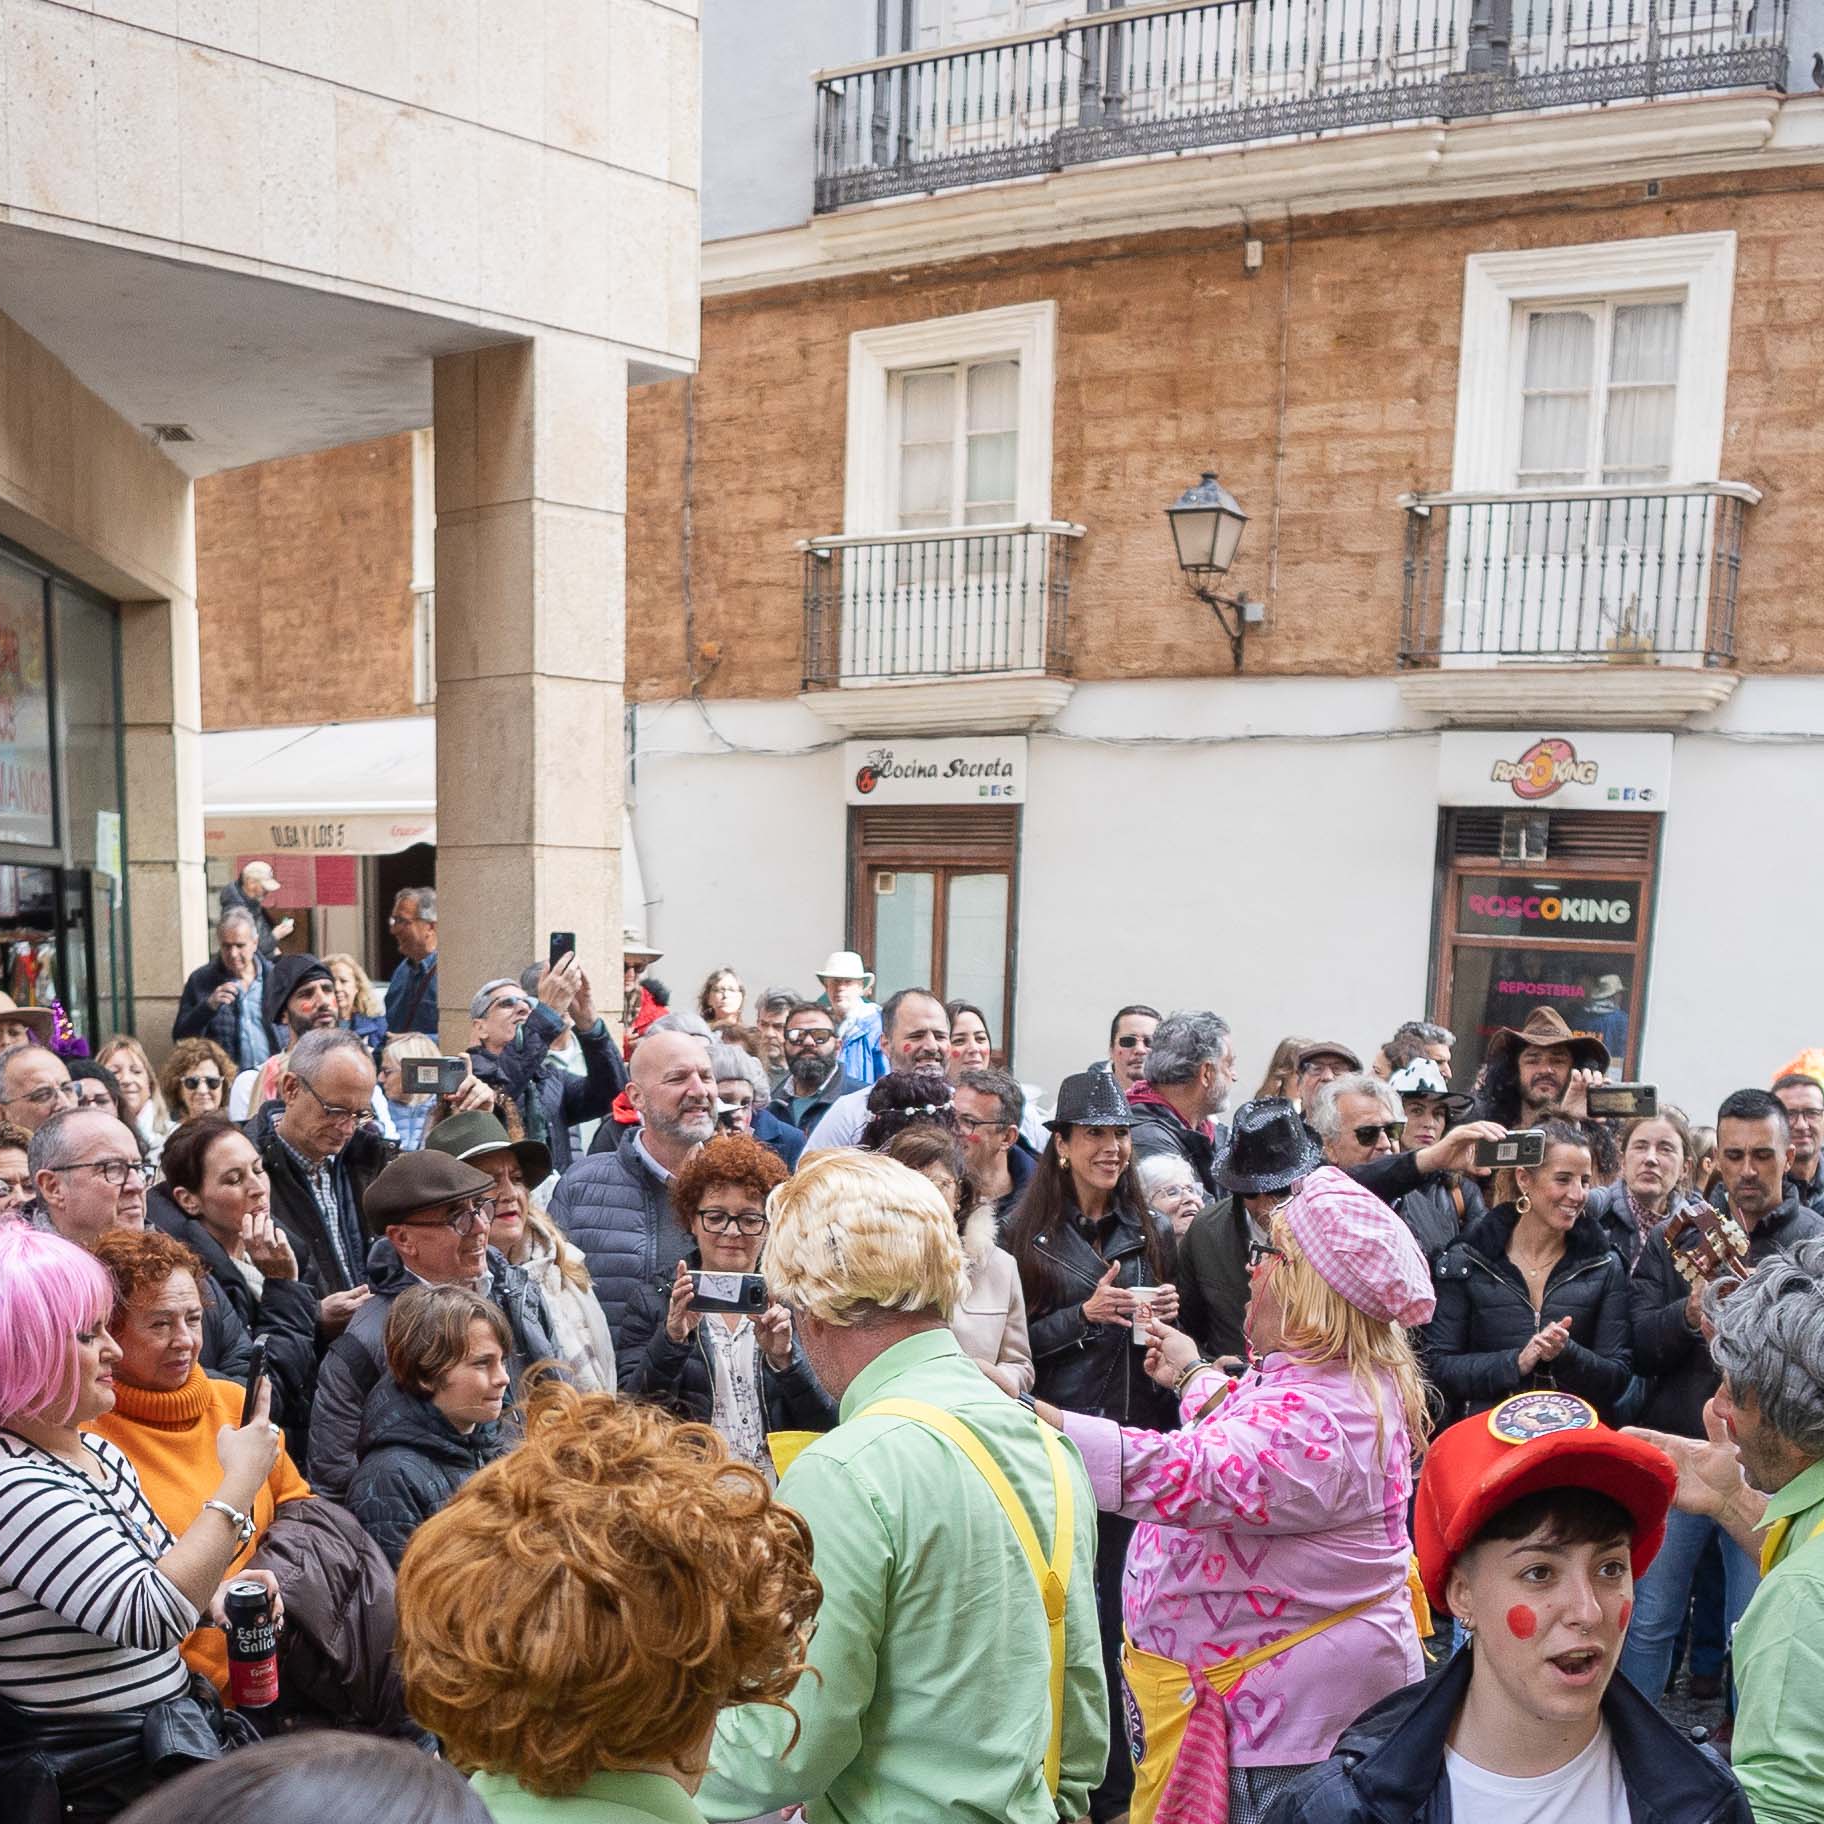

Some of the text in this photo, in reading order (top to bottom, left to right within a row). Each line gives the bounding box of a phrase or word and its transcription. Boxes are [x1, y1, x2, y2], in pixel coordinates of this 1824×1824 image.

[880, 758, 1013, 779] Cocina Secreta
[1468, 894, 1632, 925] ROSCOKING
[1498, 980, 1585, 998] REPOSTERIA
[1500, 1395, 1585, 1424] LA CHIRIGOTA
[1504, 1426, 1527, 1438] DEL
